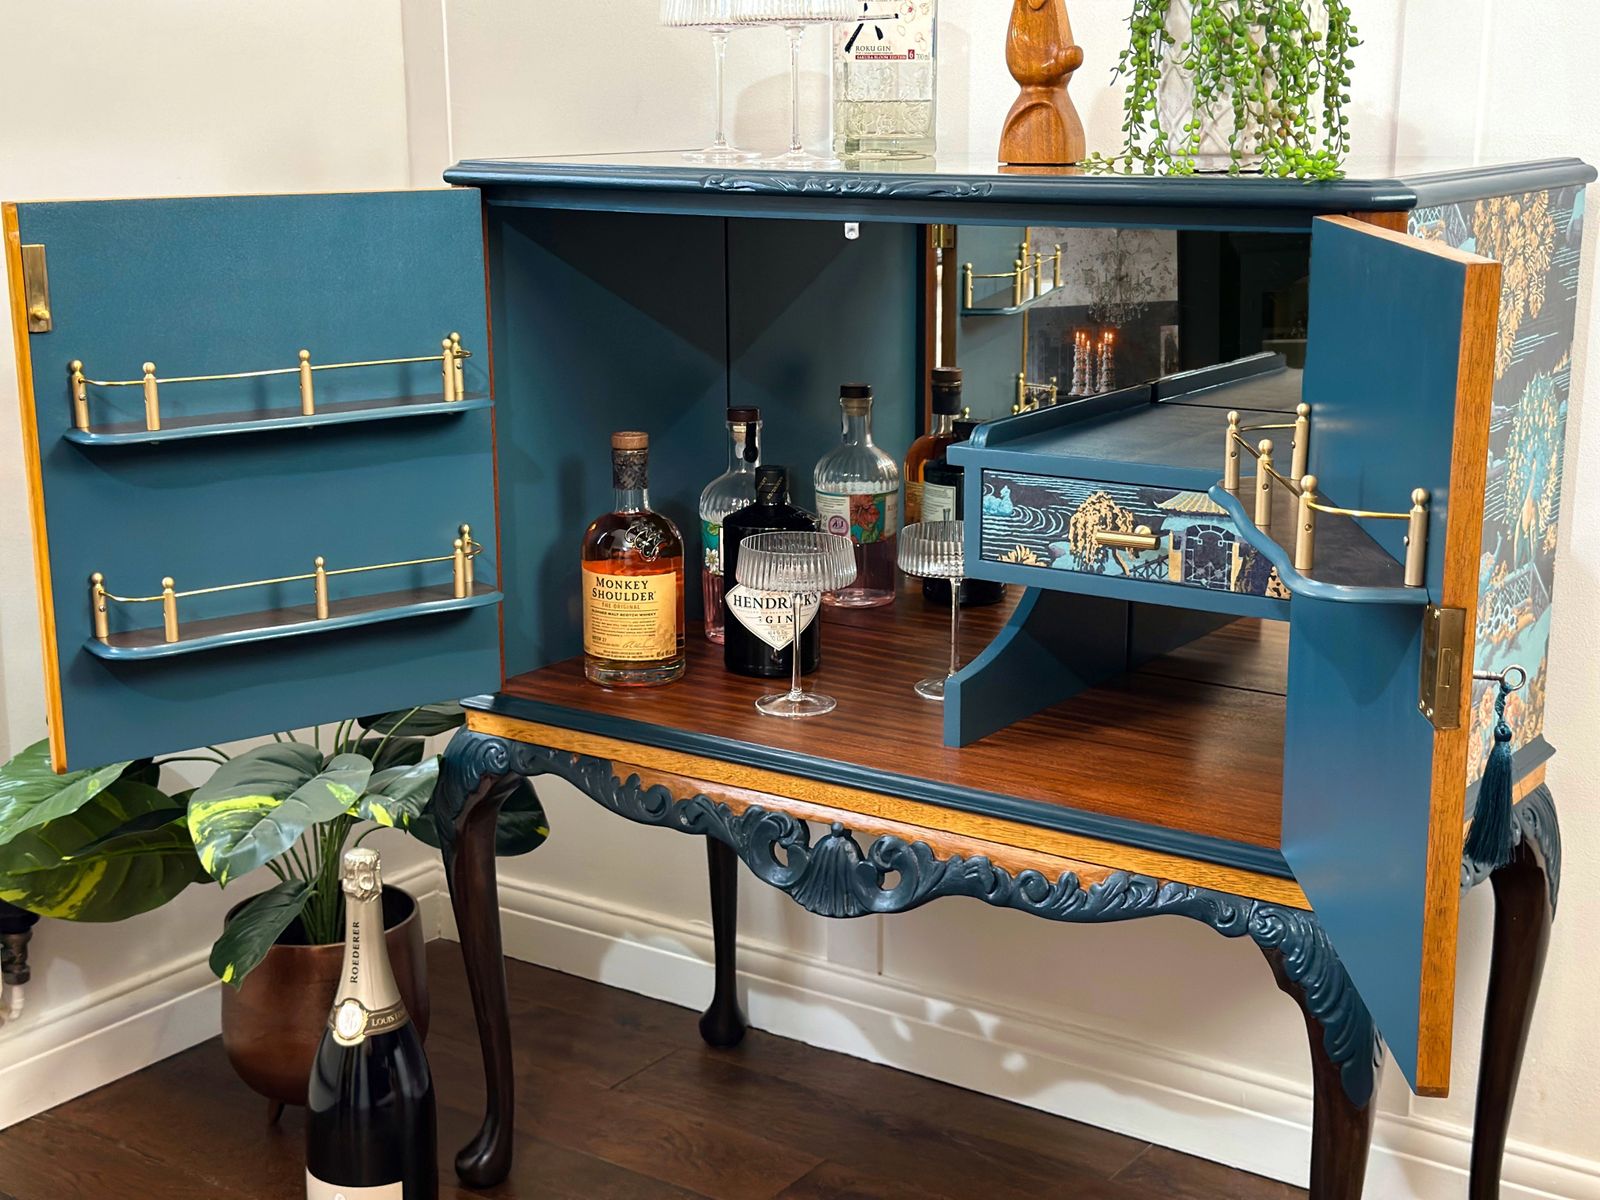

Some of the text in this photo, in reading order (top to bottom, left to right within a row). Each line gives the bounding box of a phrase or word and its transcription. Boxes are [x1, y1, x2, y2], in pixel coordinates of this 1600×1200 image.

[596, 576, 648, 590] MONKEY
[592, 587, 655, 601] SHOULDER
[733, 592, 818, 609] HENDRK'S
[765, 615, 793, 624] GIN
[350, 921, 360, 983] ROEDERER
[371, 1014, 395, 1027] LOUIS
